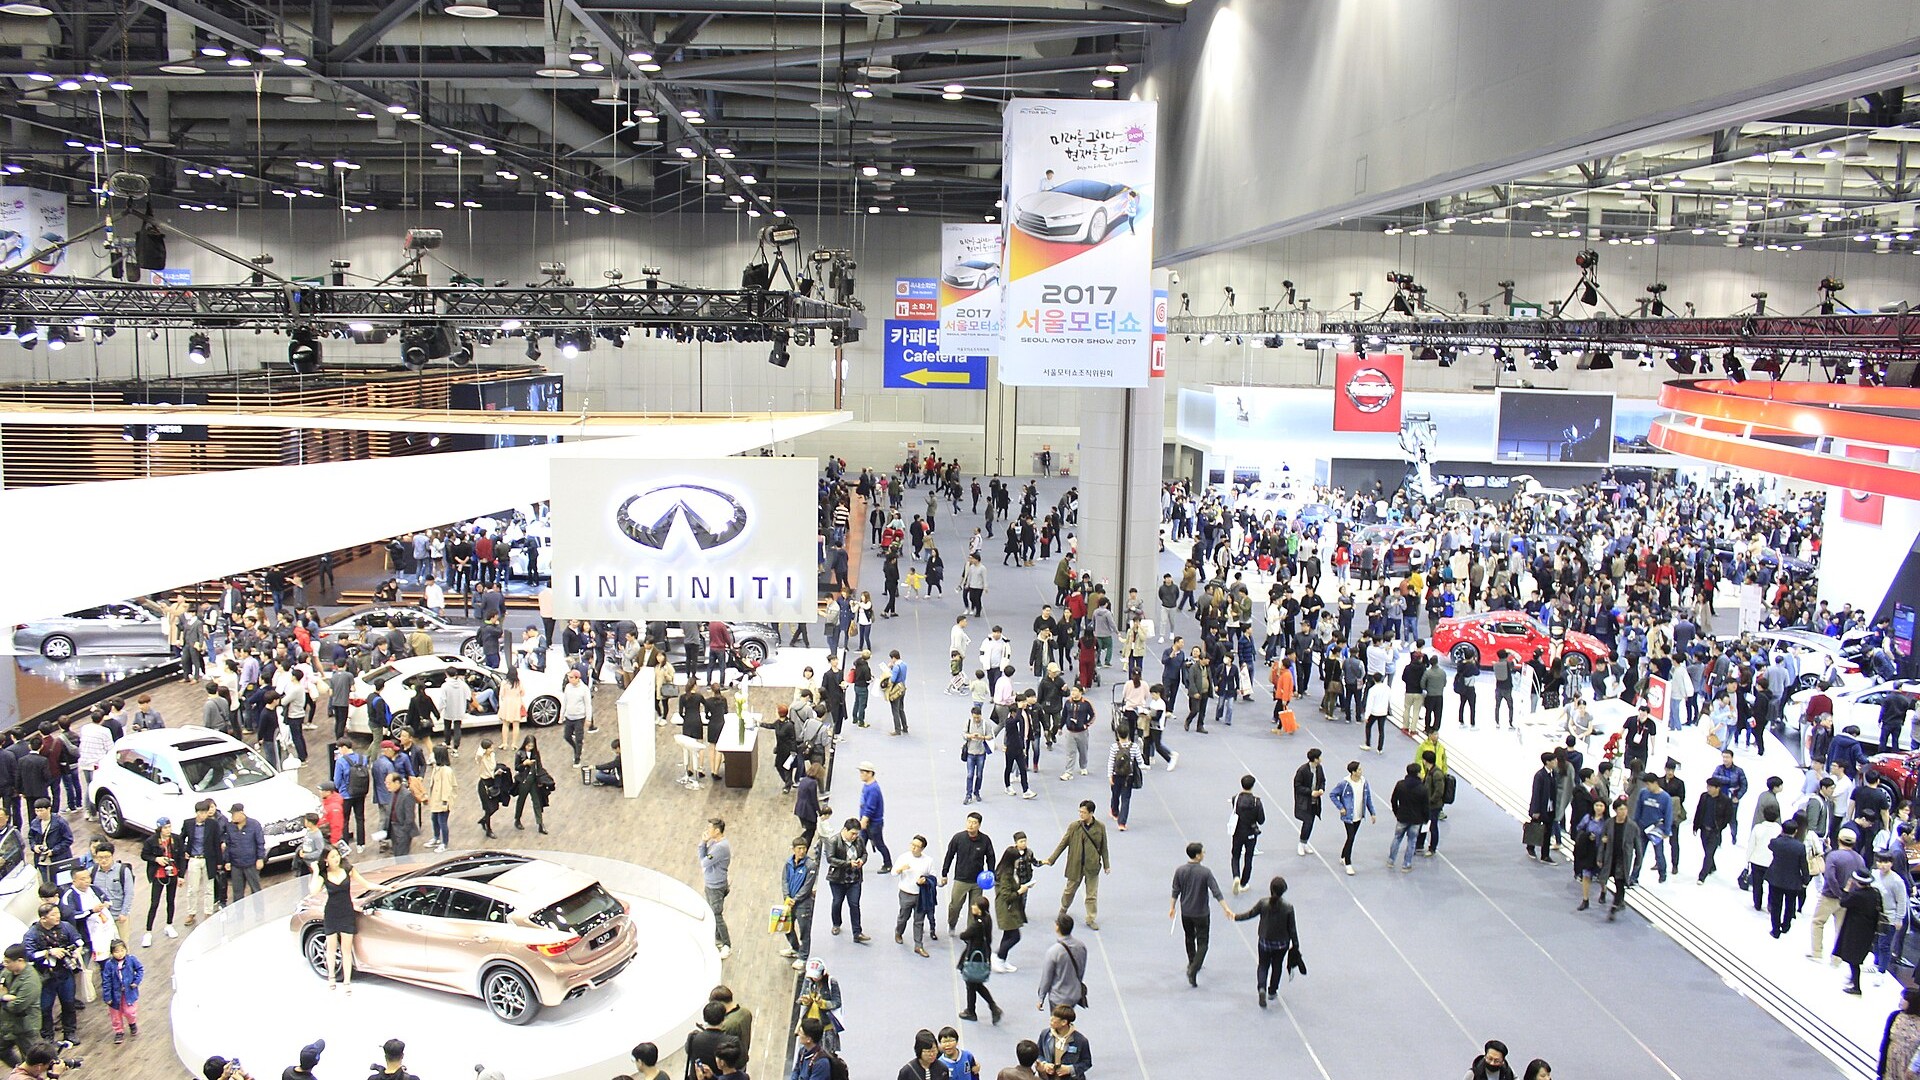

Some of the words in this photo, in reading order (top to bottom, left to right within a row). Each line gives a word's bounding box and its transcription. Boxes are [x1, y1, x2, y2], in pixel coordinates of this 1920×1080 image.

[1050, 129, 1084, 147] 미래를
[1085, 129, 1122, 143] 그리다
[1065, 143, 1098, 162] 현재를
[1099, 143, 1136, 161] 즐기다
[1042, 285, 1117, 304] 2017
[956, 309, 991, 318] 2017
[1017, 309, 1142, 334] 서울모터쇼
[1043, 369, 1113, 377] 서울모터쇼조직위원회
[575, 575, 792, 599] INFINITI
